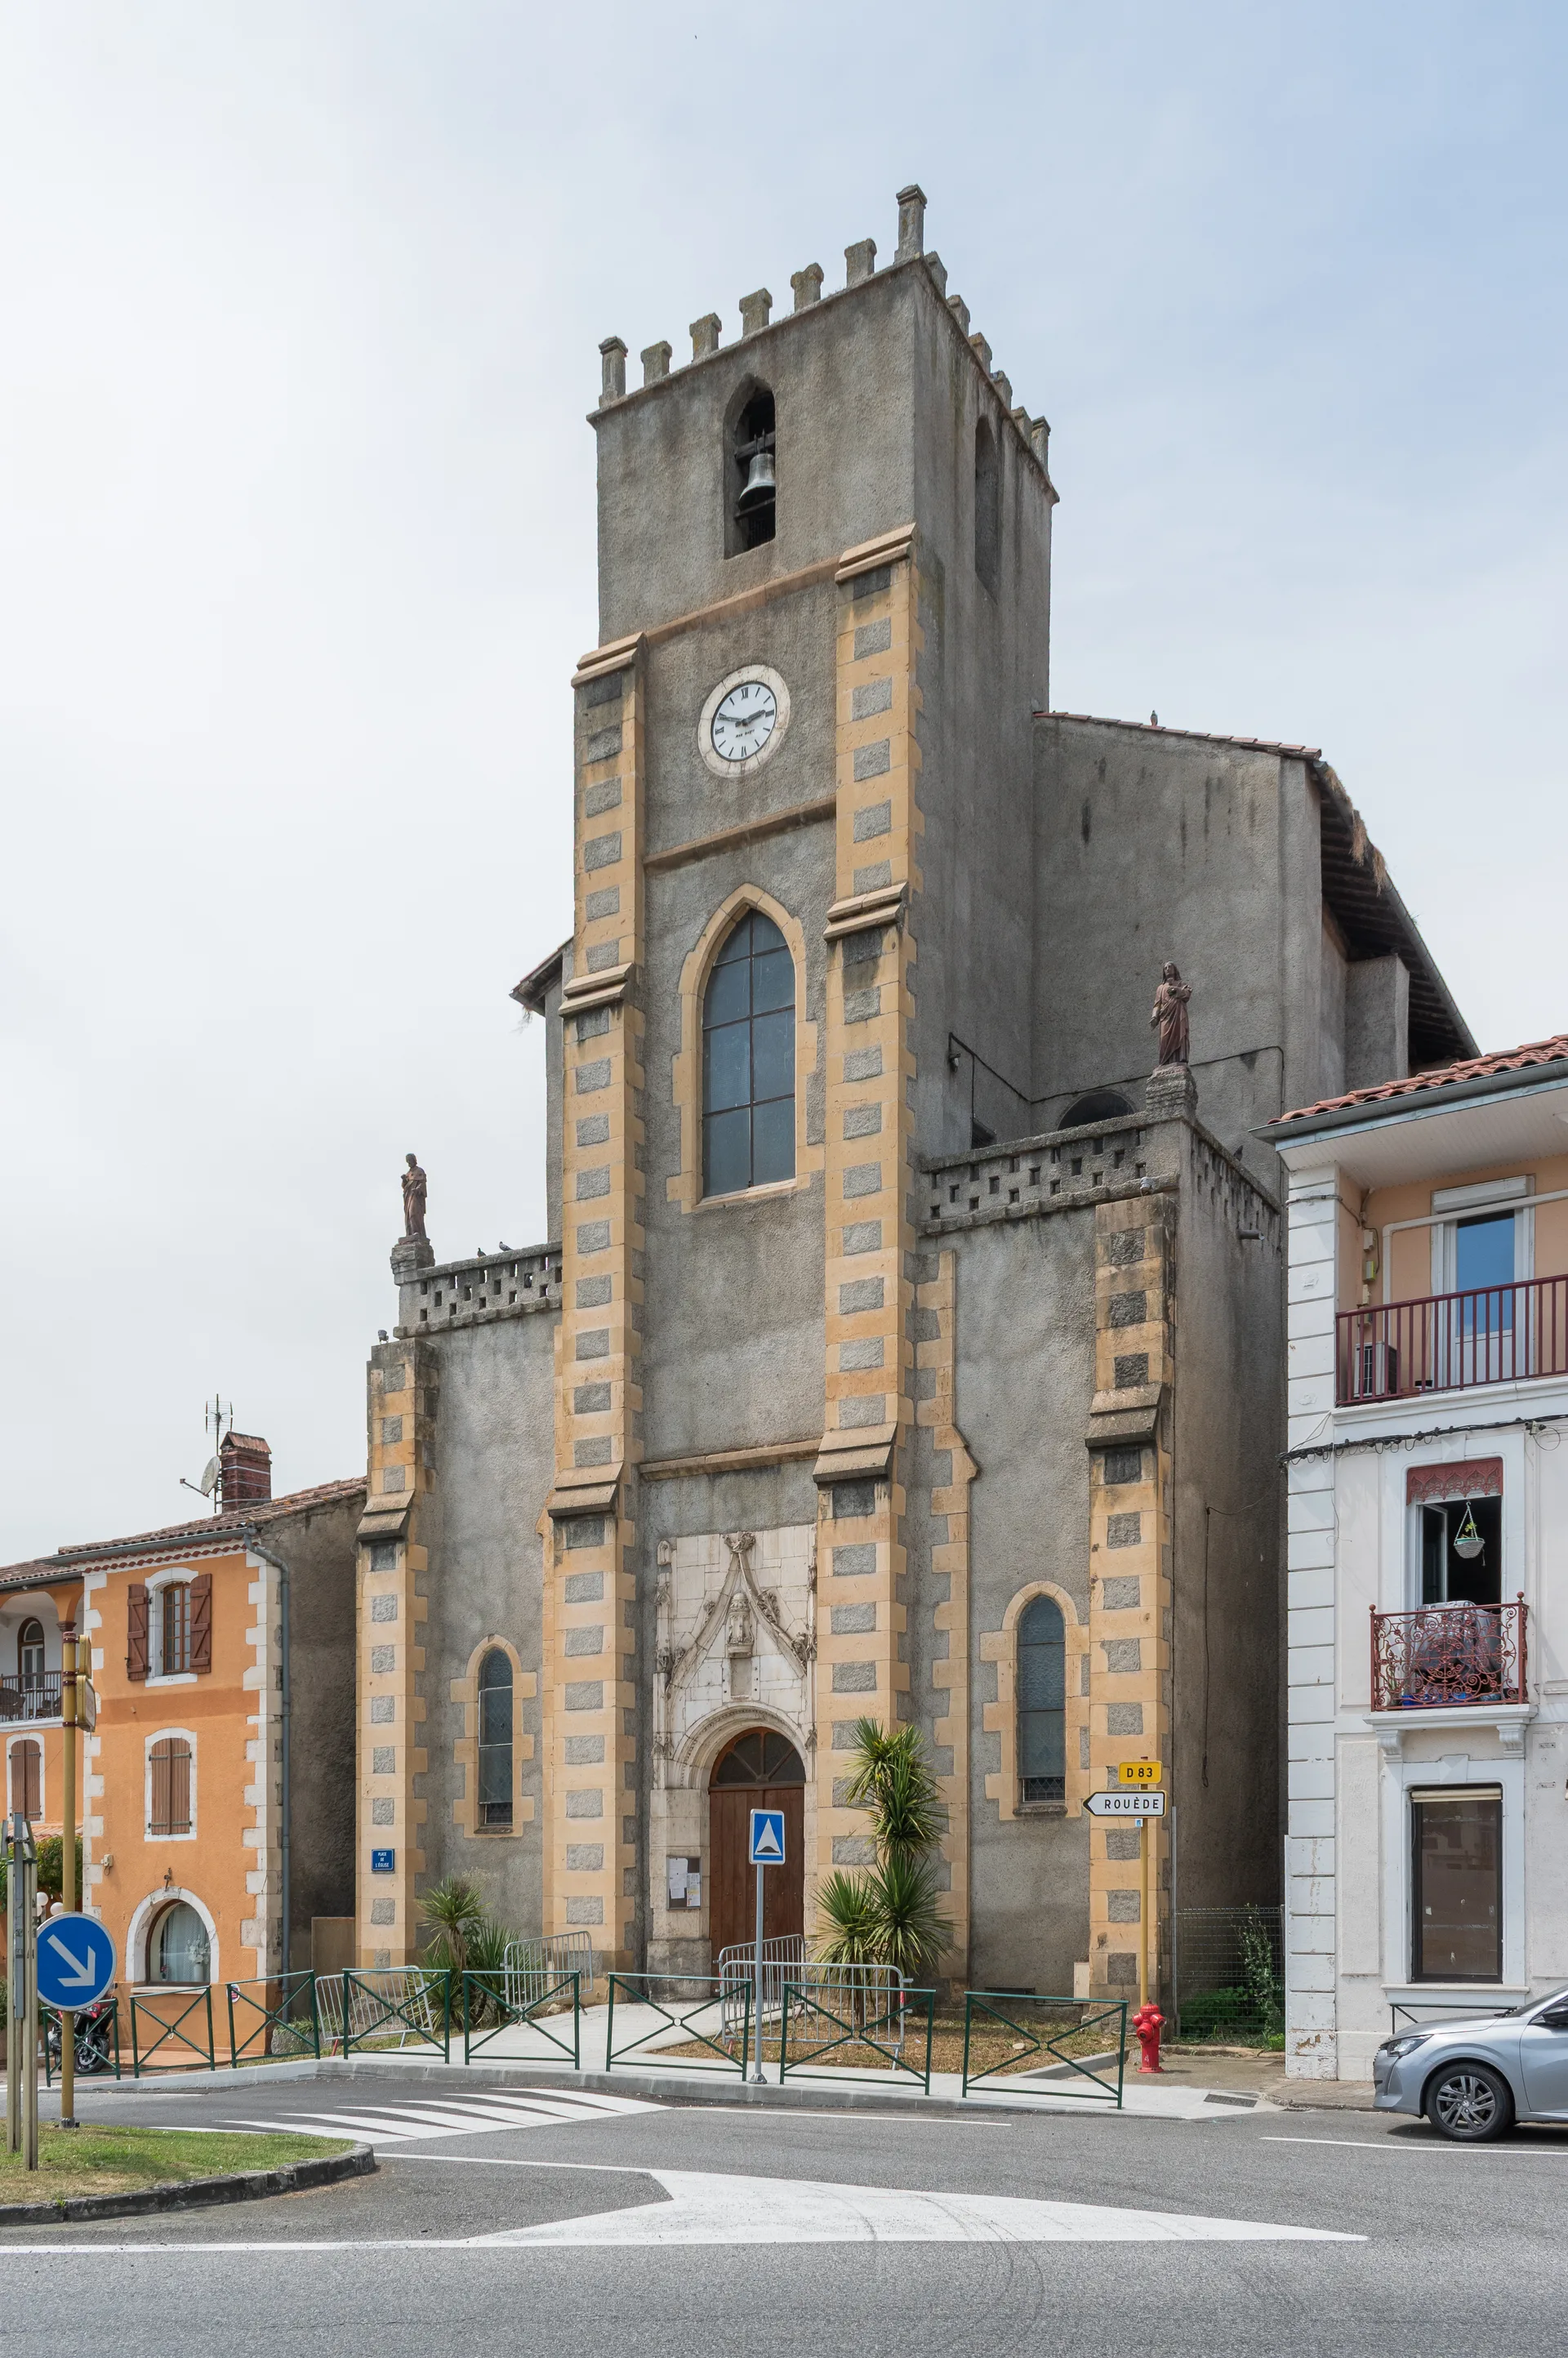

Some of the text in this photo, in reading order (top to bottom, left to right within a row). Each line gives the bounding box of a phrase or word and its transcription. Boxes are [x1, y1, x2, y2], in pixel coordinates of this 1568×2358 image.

[1126, 1767, 1153, 1777] D 83
[1104, 1797, 1160, 1809] ROUÈDE
